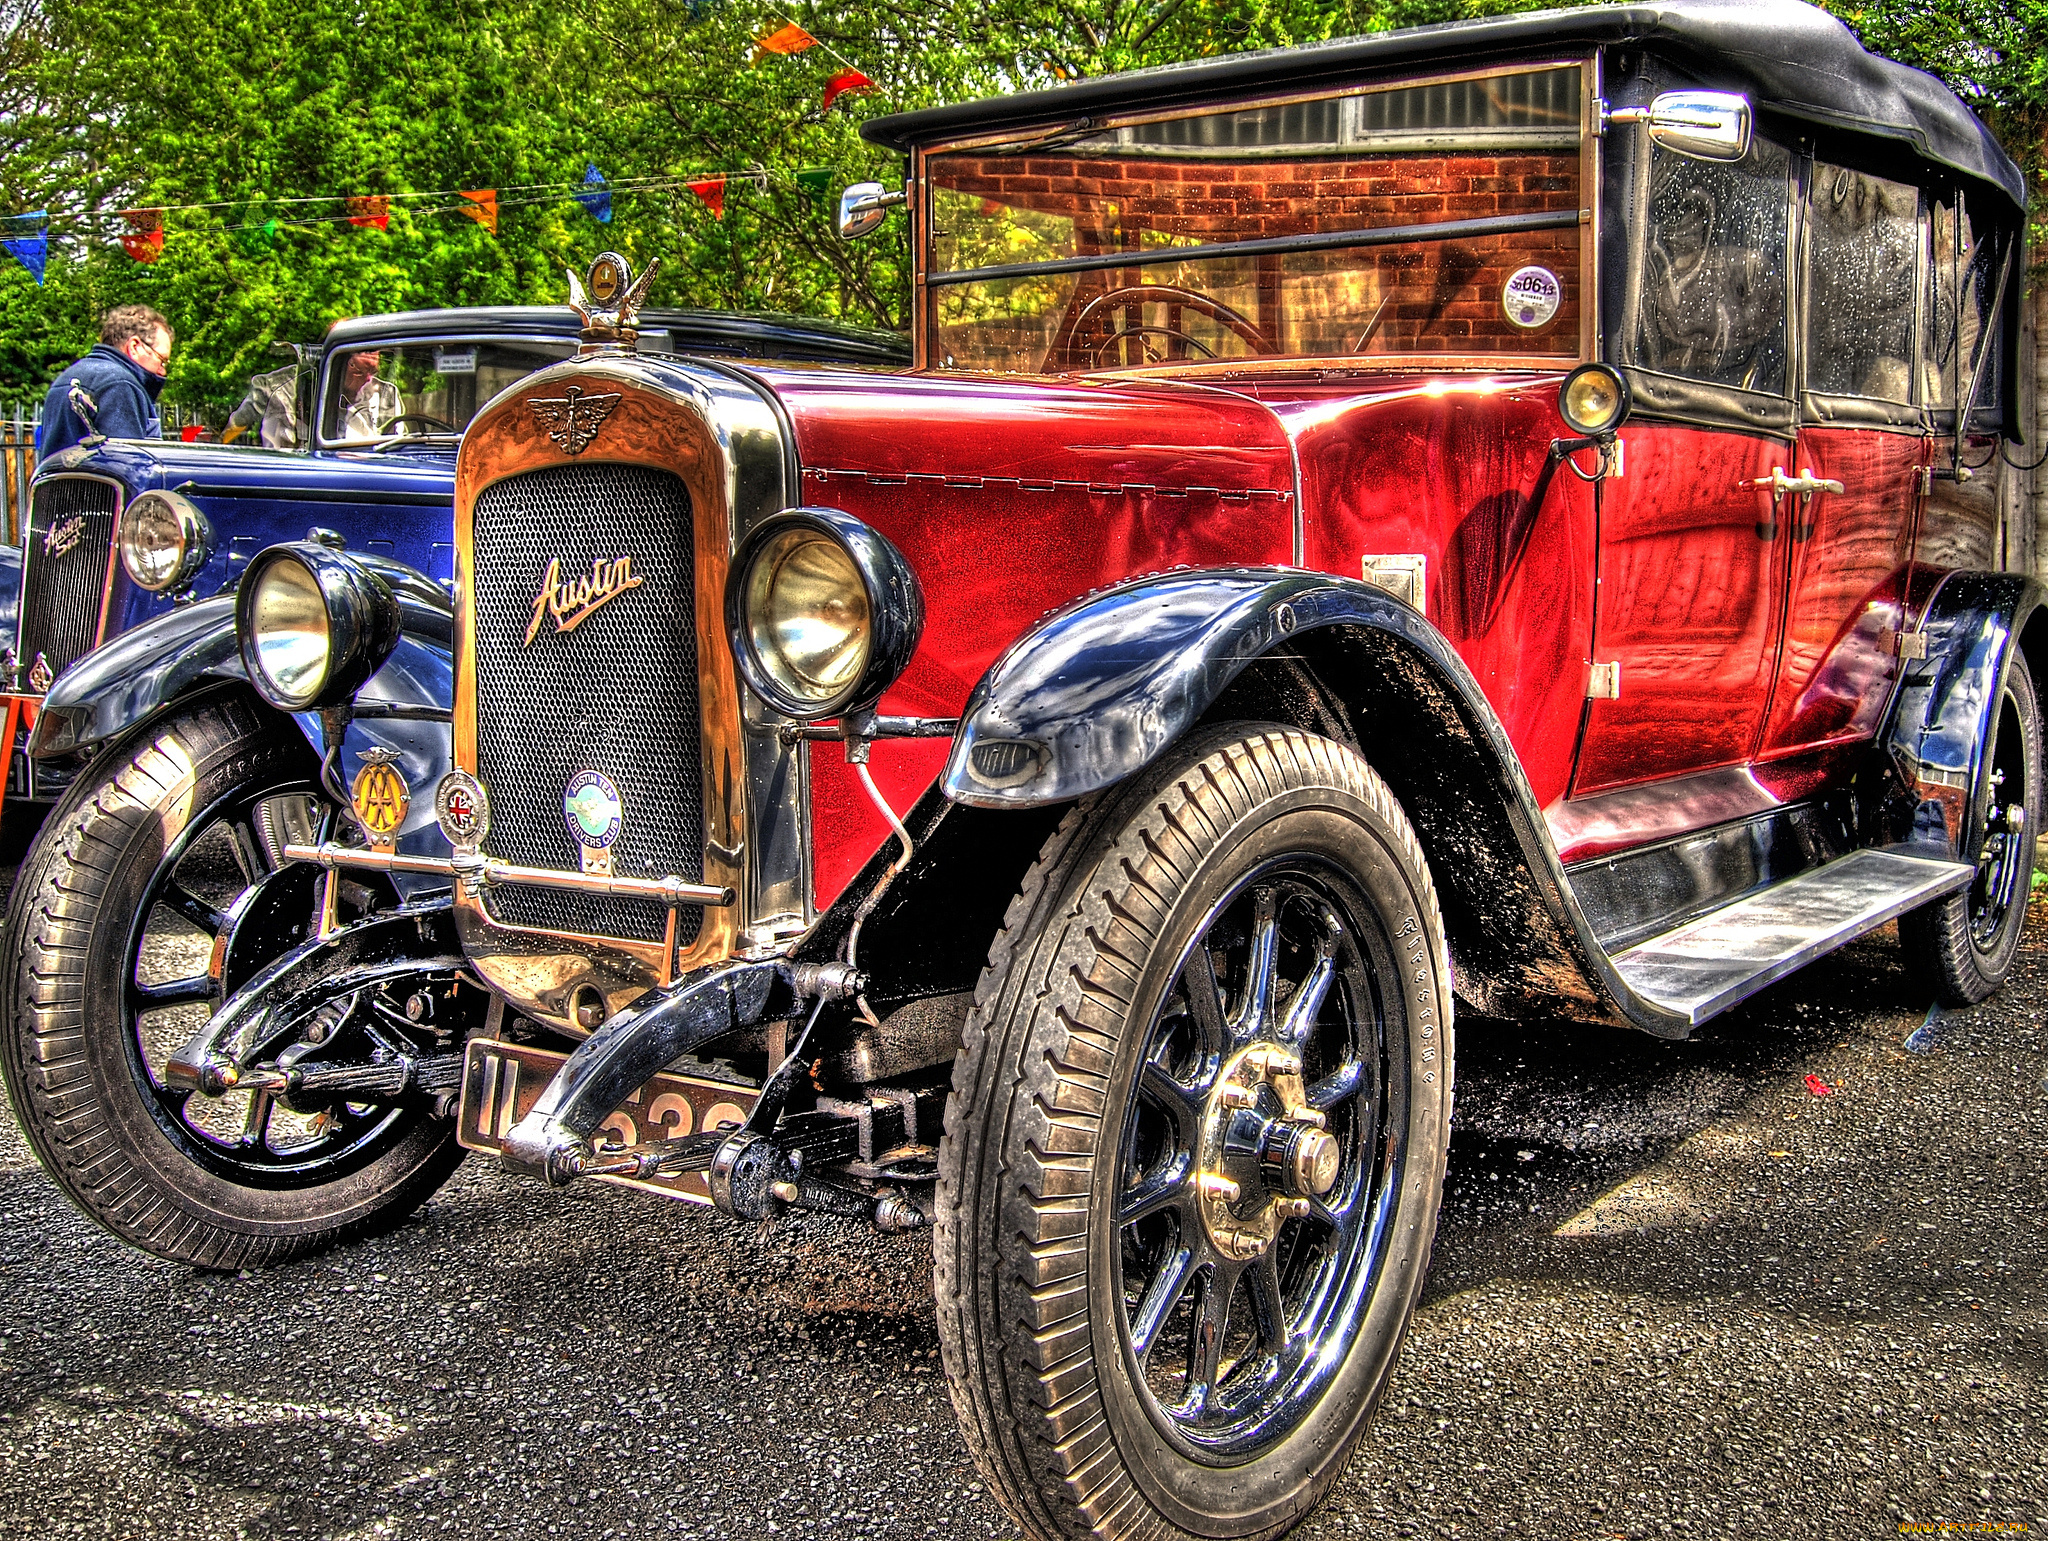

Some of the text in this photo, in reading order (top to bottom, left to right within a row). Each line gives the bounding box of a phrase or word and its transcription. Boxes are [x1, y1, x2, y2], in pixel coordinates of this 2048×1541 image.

[1523, 277, 1541, 293] 06
[1542, 284, 1554, 295] 13
[44, 516, 86, 556] Austin
[524, 556, 643, 648] Austin
[571, 774, 614, 799] AUSTIN TEN
[569, 815, 620, 848] DRIVERS CLUB
